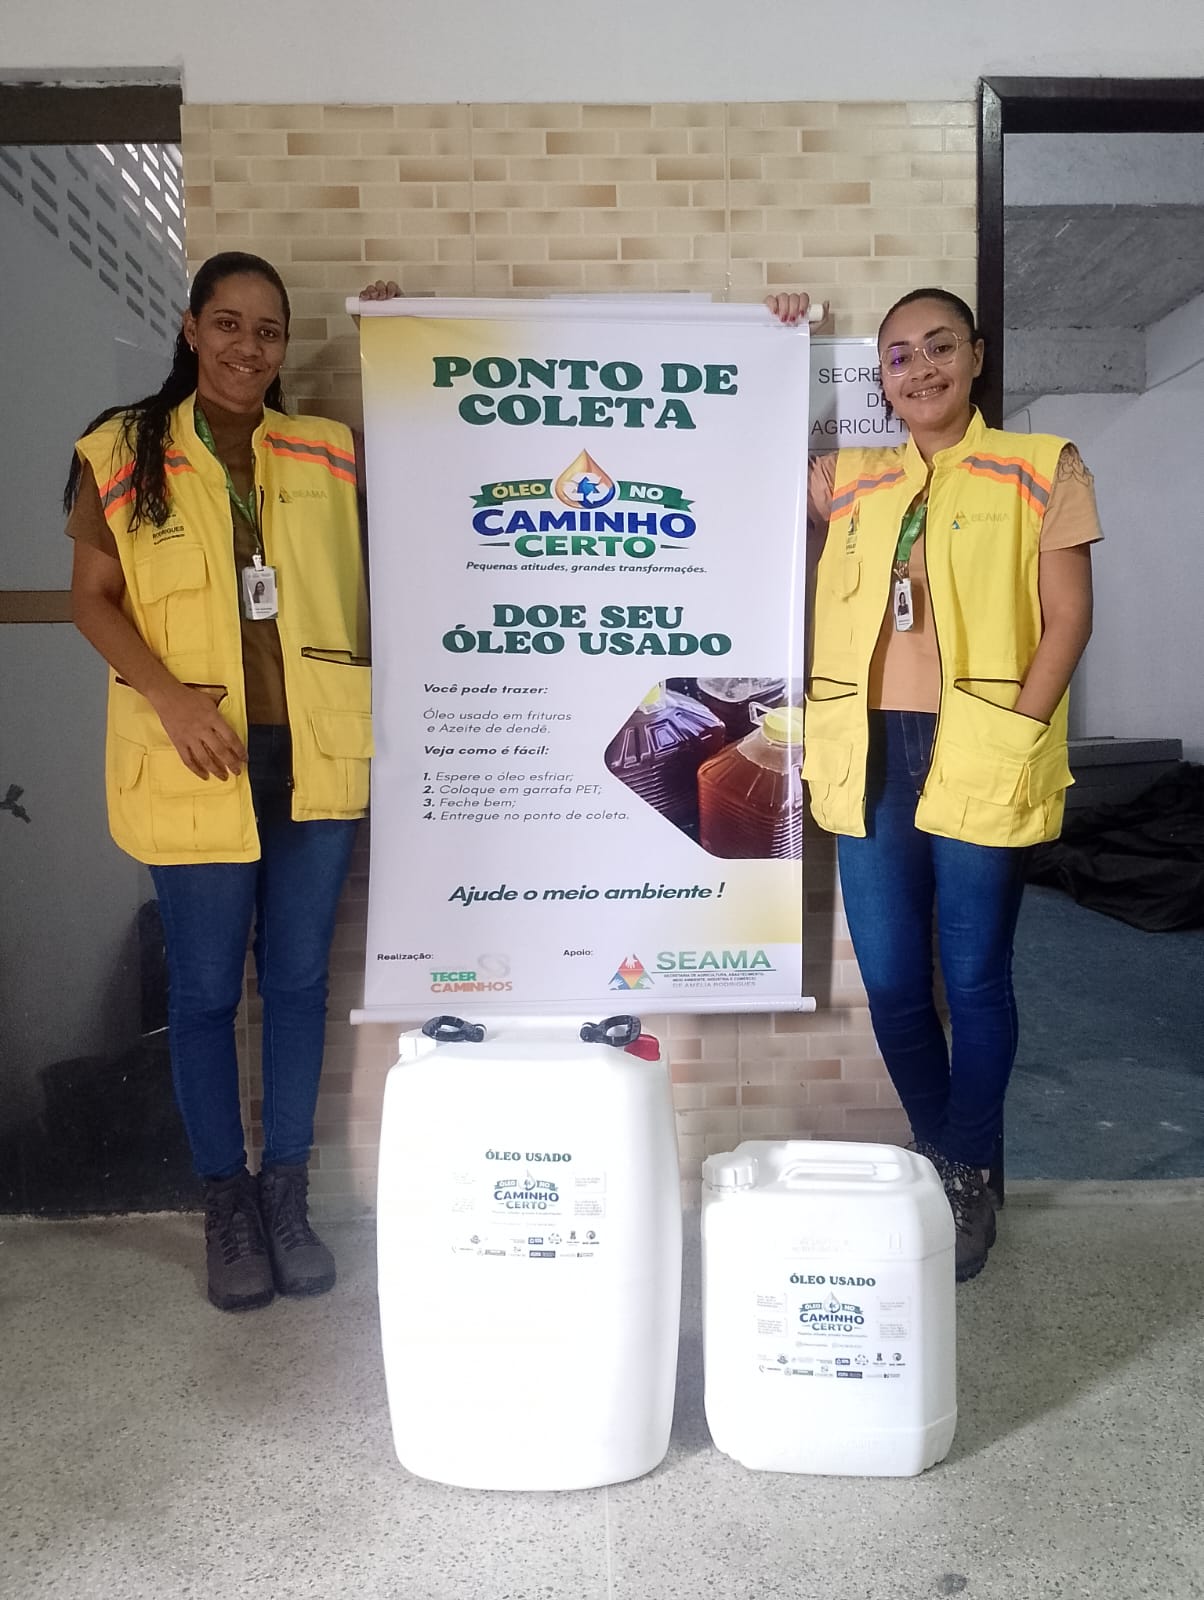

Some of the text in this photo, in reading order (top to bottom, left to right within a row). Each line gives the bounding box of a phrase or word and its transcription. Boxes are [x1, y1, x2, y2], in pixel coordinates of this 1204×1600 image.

[432, 356, 738, 395] PONTO DE
[818, 367, 881, 384] SECRE
[458, 394, 697, 430] COLETA
[811, 419, 905, 435] AGRICULT
[492, 481, 665, 501] ÓLEO NO
[472, 509, 696, 539] CAMINHO
[514, 535, 656, 559] CERTO
[466, 561, 708, 575] Pequenas atitudes, grandes transformações.
[493, 604, 683, 630] DOE SEU
[442, 624, 732, 656] ÓLEO USADO
[423, 684, 548, 696] Você pode trazer:
[423, 708, 572, 722] Óleo usado em frituras
[427, 726, 434, 734] e
[439, 723, 481, 734] Azeite
[485, 723, 502, 734] de
[423, 745, 549, 757] Veja como é fácil:
[423, 773, 432, 782] 1.
[436, 772, 480, 784] Espere
[498, 771, 525, 782] óleo
[530, 771, 574, 782] esfriar;
[423, 785, 602, 797] 2. Coloque em garrafa PET;
[423, 798, 516, 808] 3. Feche bem;
[423, 811, 436, 820] 4.
[440, 811, 499, 823] Entregue
[524, 811, 561, 822] ponto
[566, 810, 581, 820] de
[586, 810, 629, 820] coleta.
[449, 882, 726, 906] Ajude o meio ambiente !
[377, 952, 434, 961] Realização:
[563, 949, 593, 957] Apoio:
[656, 950, 771, 970] SEAMA
[430, 972, 477, 982] TECER
[430, 981, 512, 993] CAMINHOS
[485, 1149, 572, 1162] ÓLEO USADO
[494, 1190, 559, 1202] CAMINHO
[506, 1200, 547, 1210] CERTO
[790, 1273, 876, 1286] ÓLEO USADO
[800, 1313, 864, 1324] CAMINHO
[812, 1323, 853, 1332] CERTO
